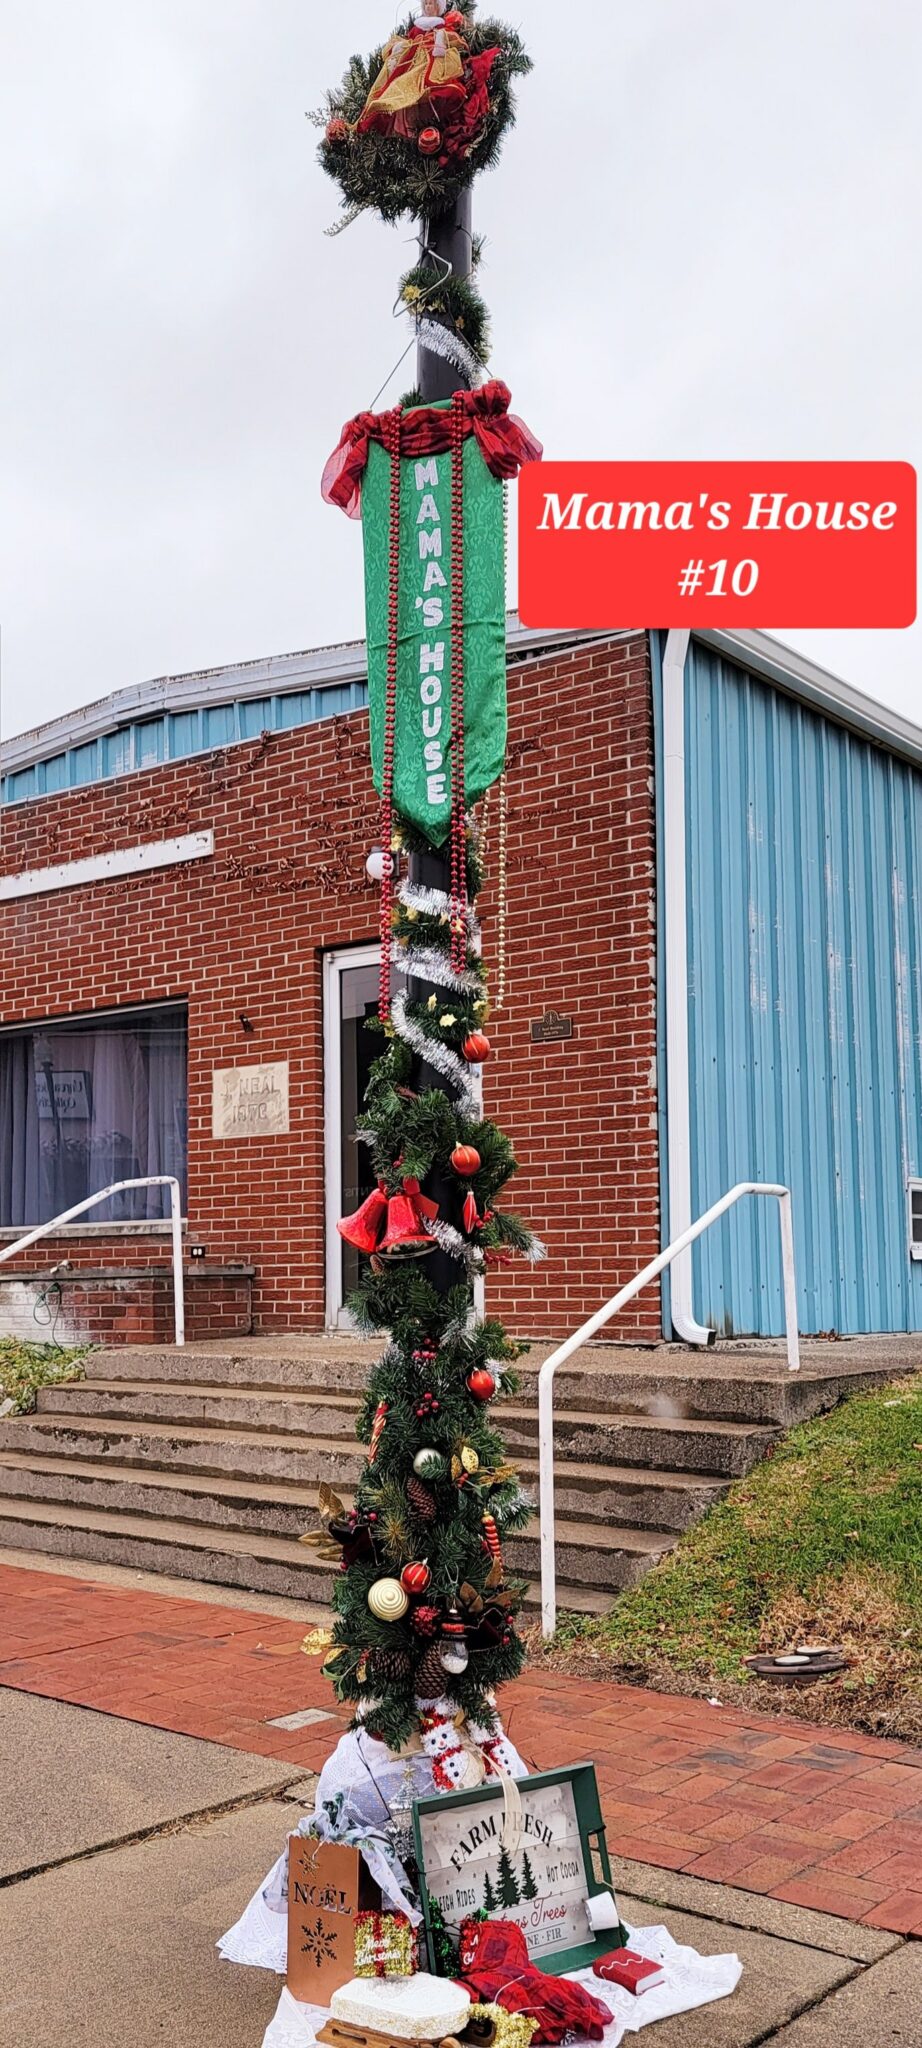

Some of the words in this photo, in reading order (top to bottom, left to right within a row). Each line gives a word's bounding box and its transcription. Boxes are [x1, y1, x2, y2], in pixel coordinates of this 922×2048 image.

[414, 456, 448, 627] MAMA'S
[419, 641, 448, 805] HOUSE
[239, 1074, 281, 1097] NEAL
[450, 1814, 497, 1873] FARM
[545, 1865, 559, 1883] HOT
[560, 1860, 580, 1880] COCOA
[455, 1888, 476, 1908] RIDES
[531, 1891, 567, 1928] Trees
[546, 1927, 562, 1942] FIR
